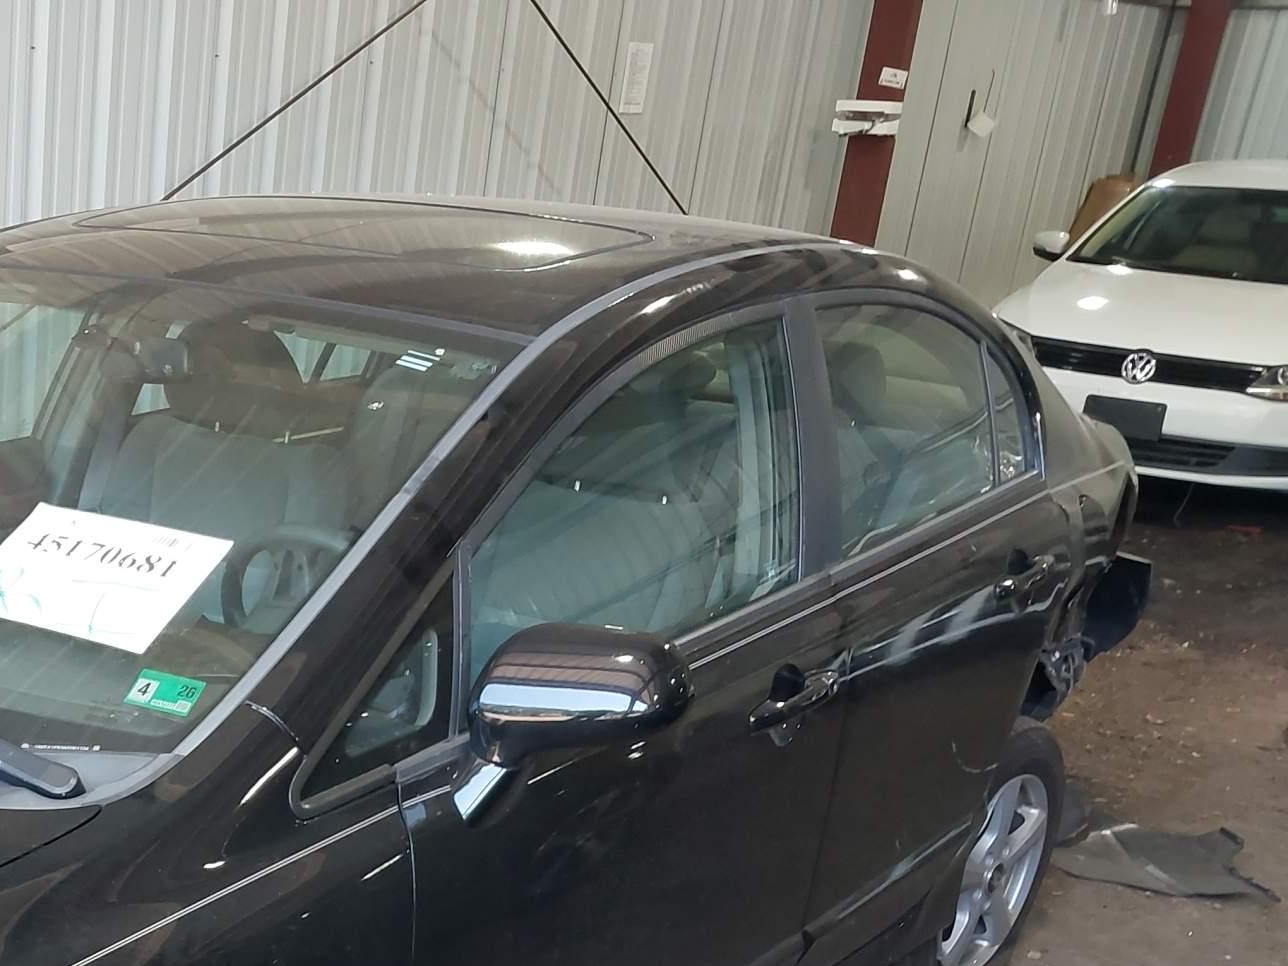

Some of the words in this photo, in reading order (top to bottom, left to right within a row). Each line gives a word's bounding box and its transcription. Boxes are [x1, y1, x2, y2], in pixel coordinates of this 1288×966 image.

[27, 533, 178, 578] 45170681
[137, 682, 152, 696] 4
[177, 685, 197, 699] 26
